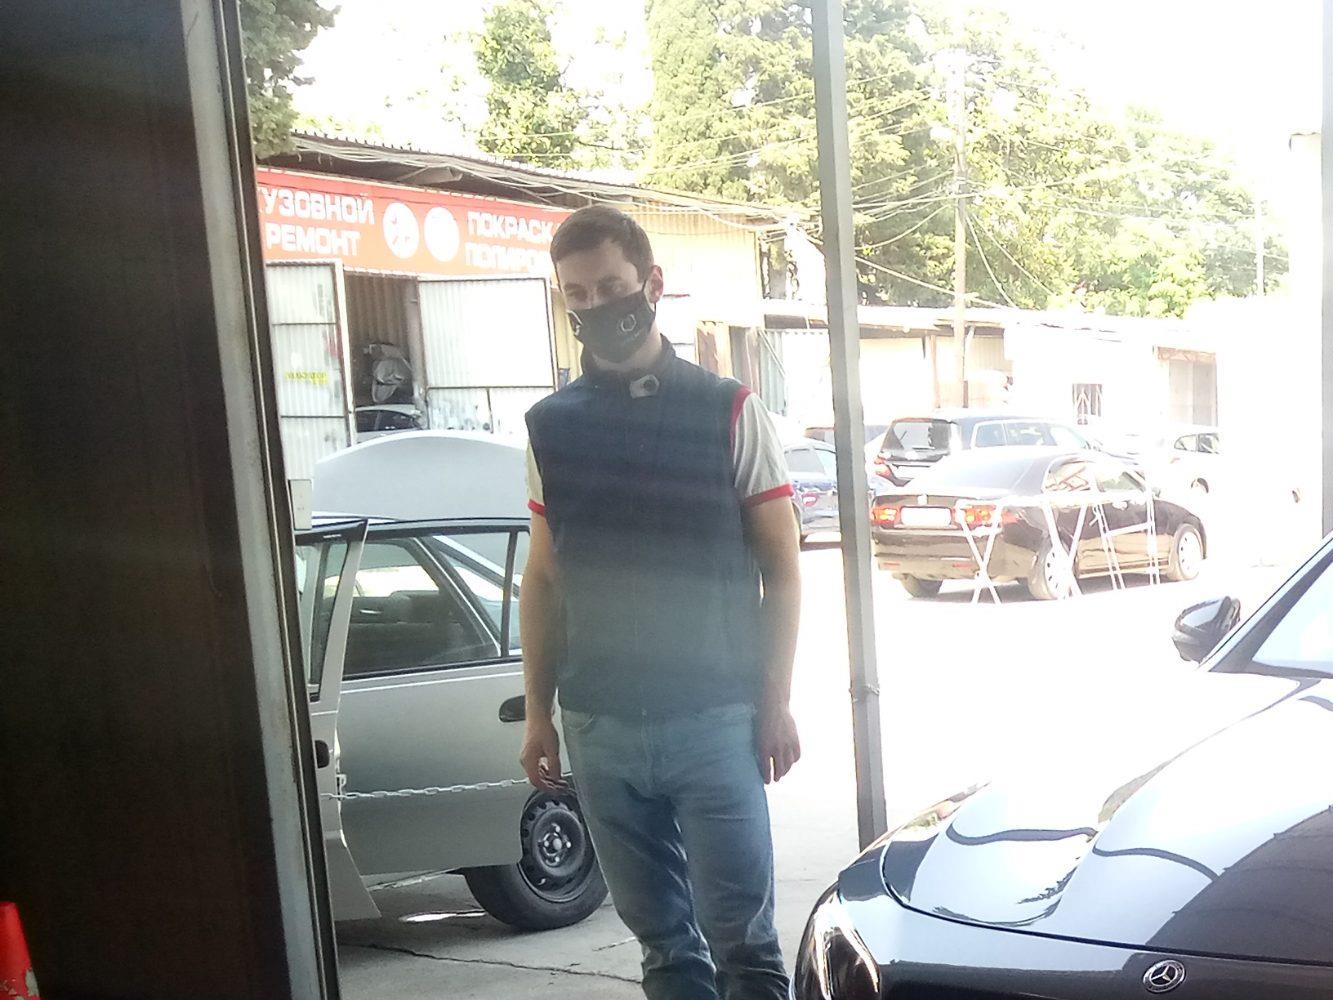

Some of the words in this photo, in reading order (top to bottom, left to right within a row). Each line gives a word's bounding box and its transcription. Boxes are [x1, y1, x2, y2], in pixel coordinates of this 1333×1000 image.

[257, 186, 375, 225] УЗОВНОЙ
[265, 222, 361, 256] РЕМОНТ
[464, 241, 551, 274] ПОЛИРО
